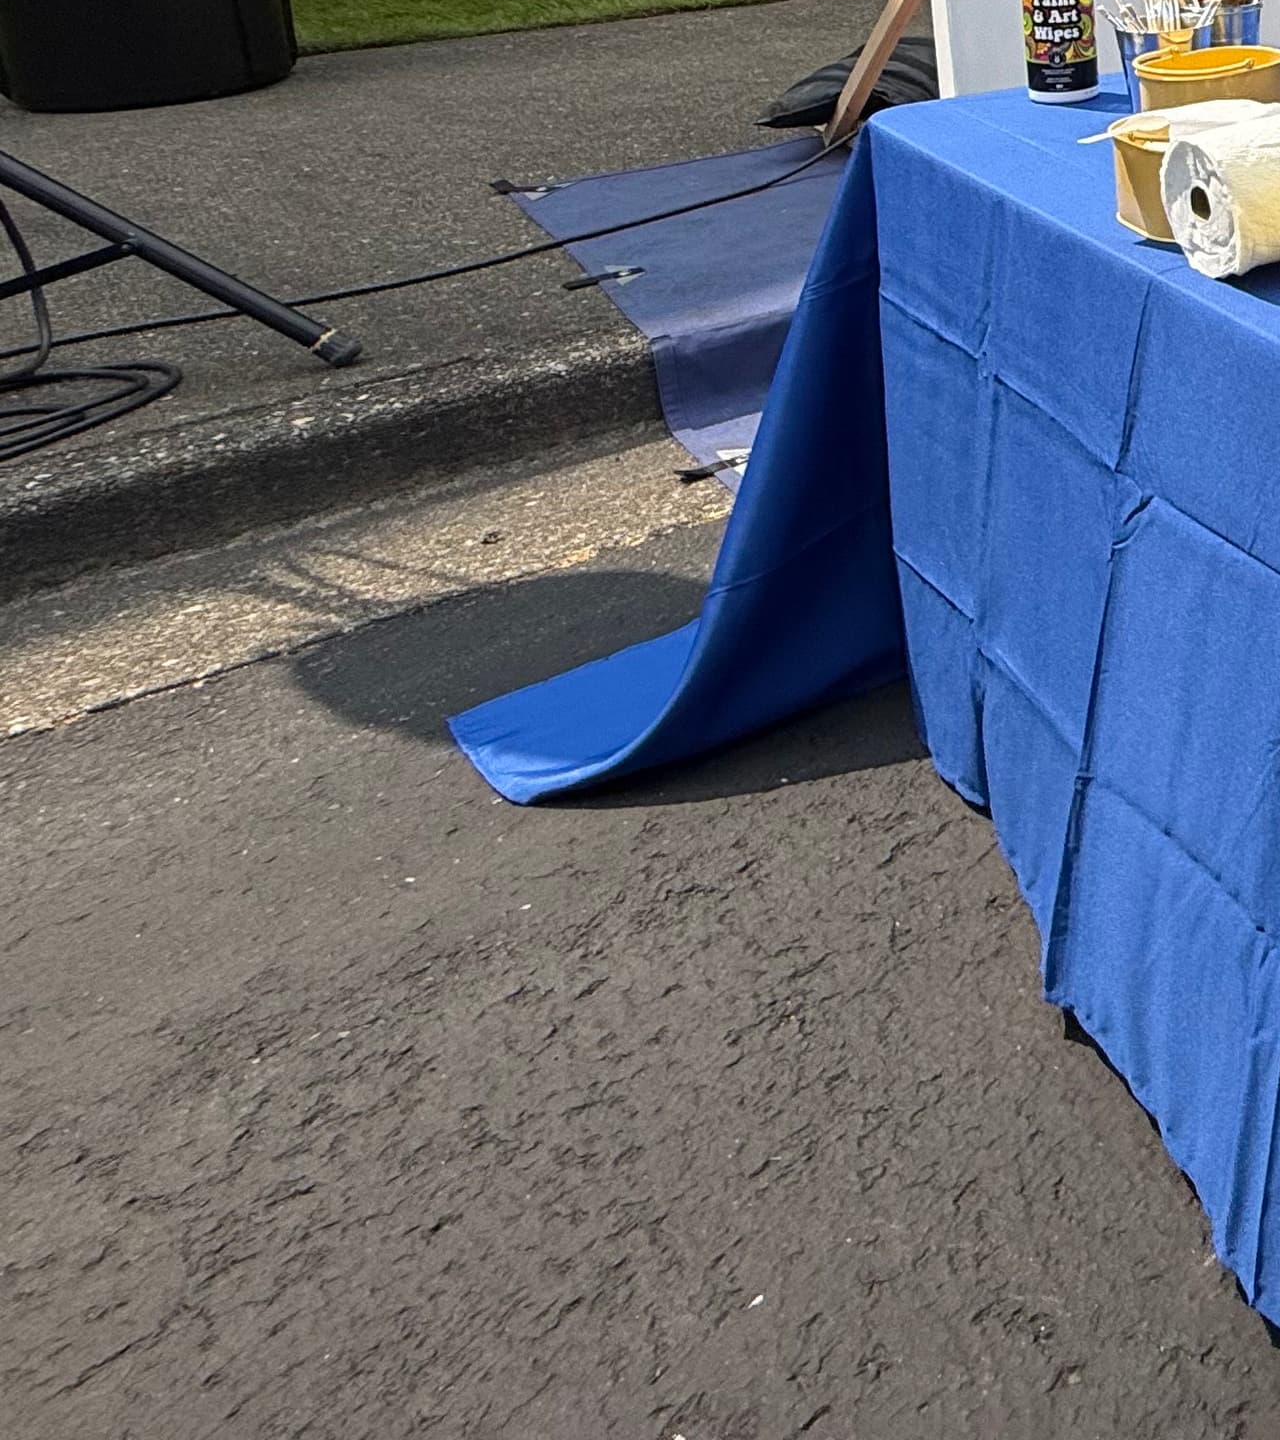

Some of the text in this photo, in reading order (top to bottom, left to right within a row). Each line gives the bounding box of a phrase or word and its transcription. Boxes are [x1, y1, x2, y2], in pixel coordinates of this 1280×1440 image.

[1033, 9, 1078, 24] & Art
[1034, 26, 1080, 42] Wipes
